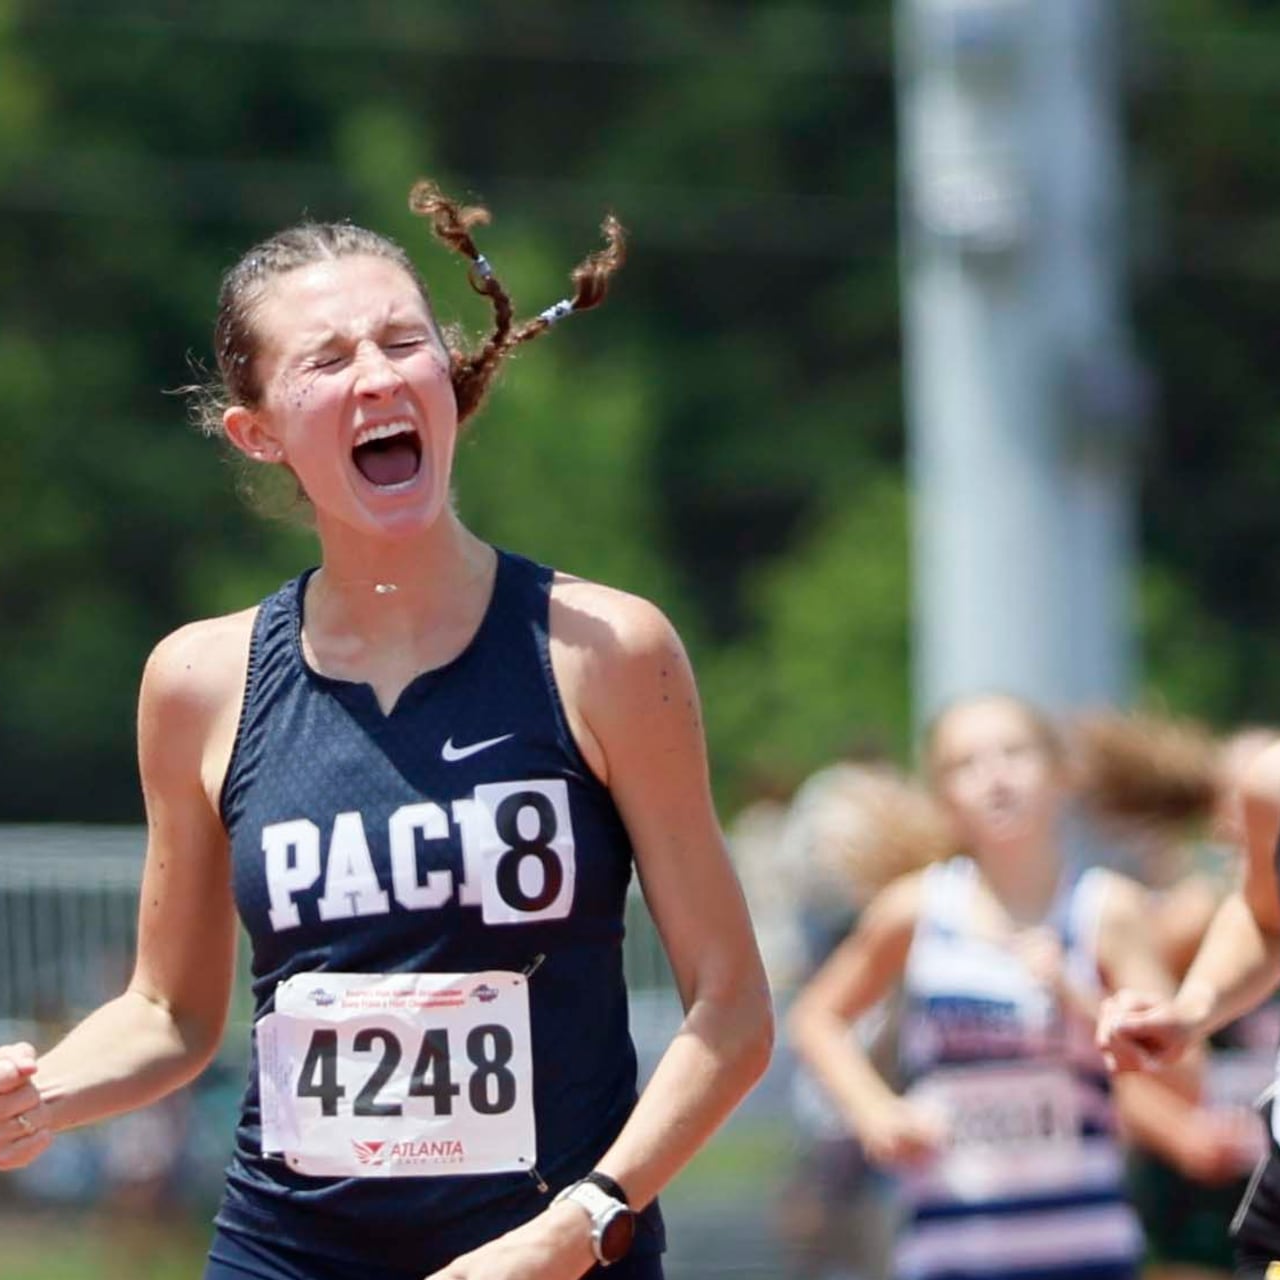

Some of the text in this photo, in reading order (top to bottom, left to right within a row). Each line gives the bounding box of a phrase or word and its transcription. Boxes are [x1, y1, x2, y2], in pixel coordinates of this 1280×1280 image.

[496, 791, 563, 912] 8
[296, 1024, 516, 1118] 4248
[391, 1139, 464, 1157] ATLANTA
